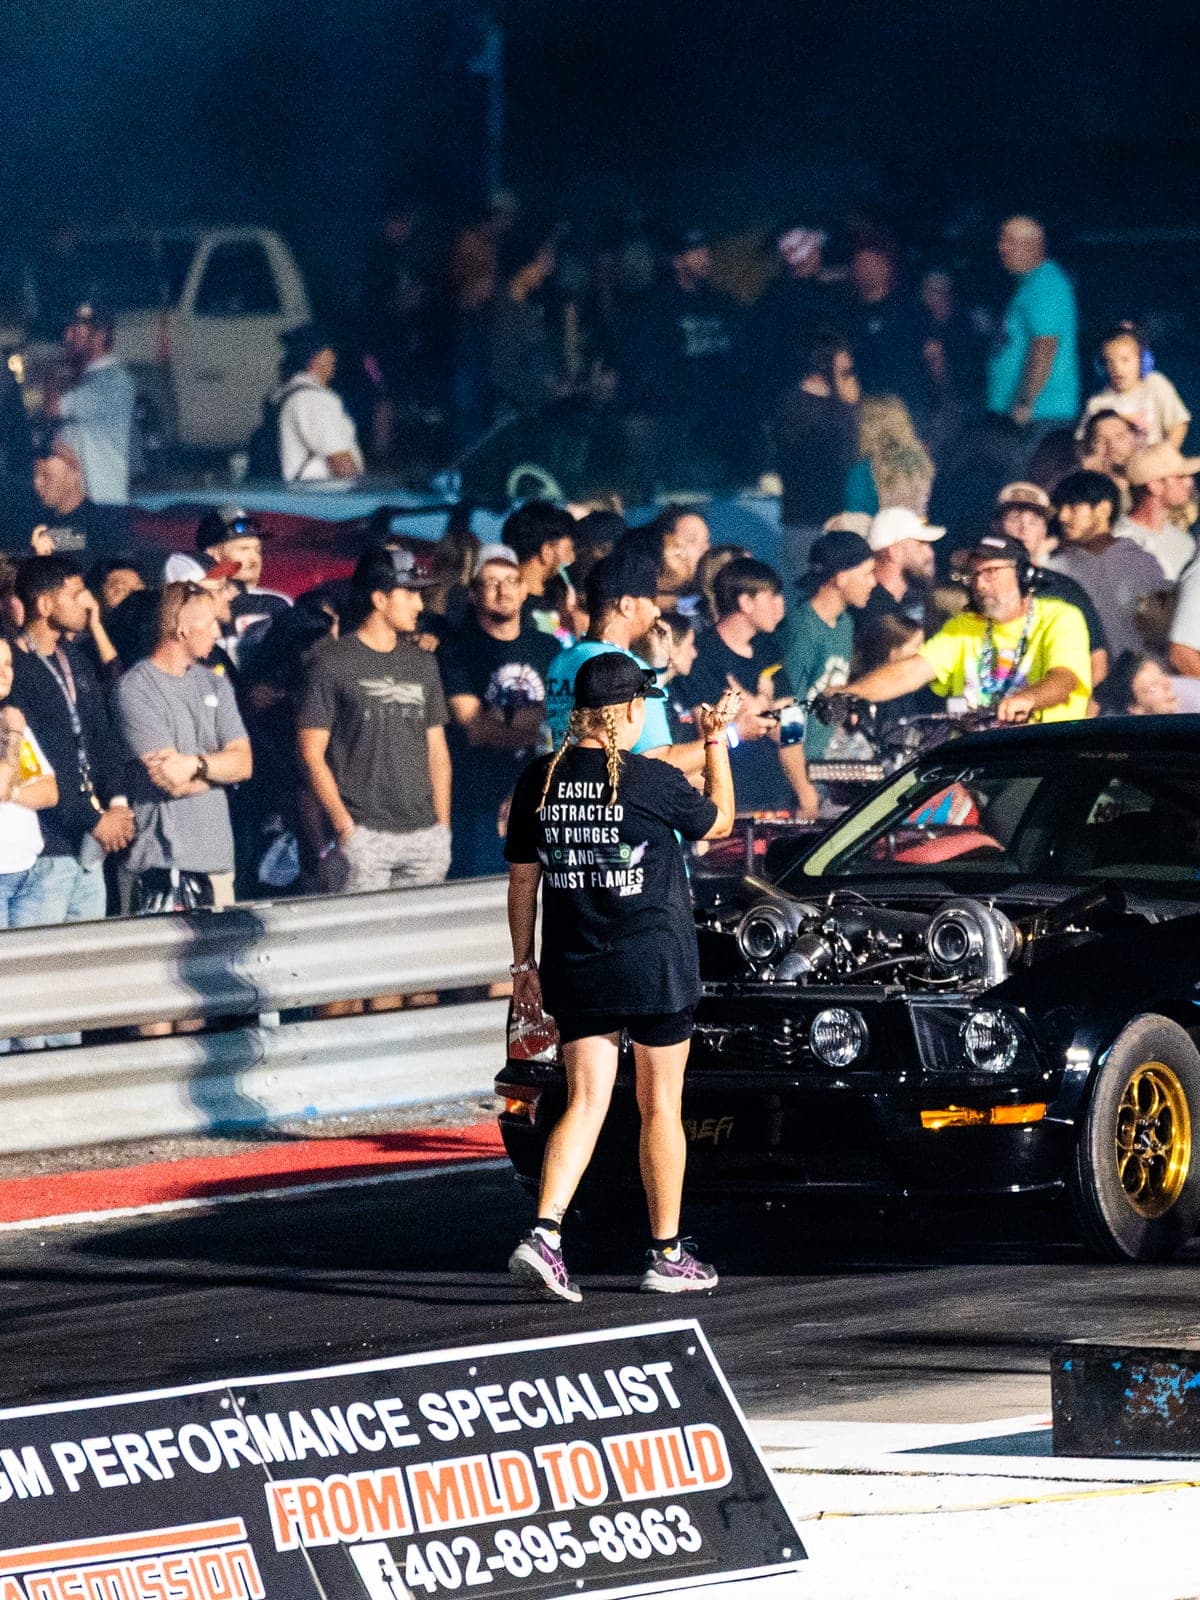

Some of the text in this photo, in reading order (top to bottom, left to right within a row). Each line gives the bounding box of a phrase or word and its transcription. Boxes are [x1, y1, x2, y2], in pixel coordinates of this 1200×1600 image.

[557, 781, 604, 799] EASILY
[540, 804, 624, 822] DISTRACTED
[545, 827, 620, 844] BY PURGES
[568, 849, 595, 867] AND
[547, 867, 644, 889] HAUST FLAMES
[51, 1402, 419, 1492] PERFORMANCE
[426, 1360, 681, 1441] SPECIALIST
[266, 1422, 732, 1551] FROM MILD TO WILD
[404, 1504, 703, 1595] 402-895-8863
